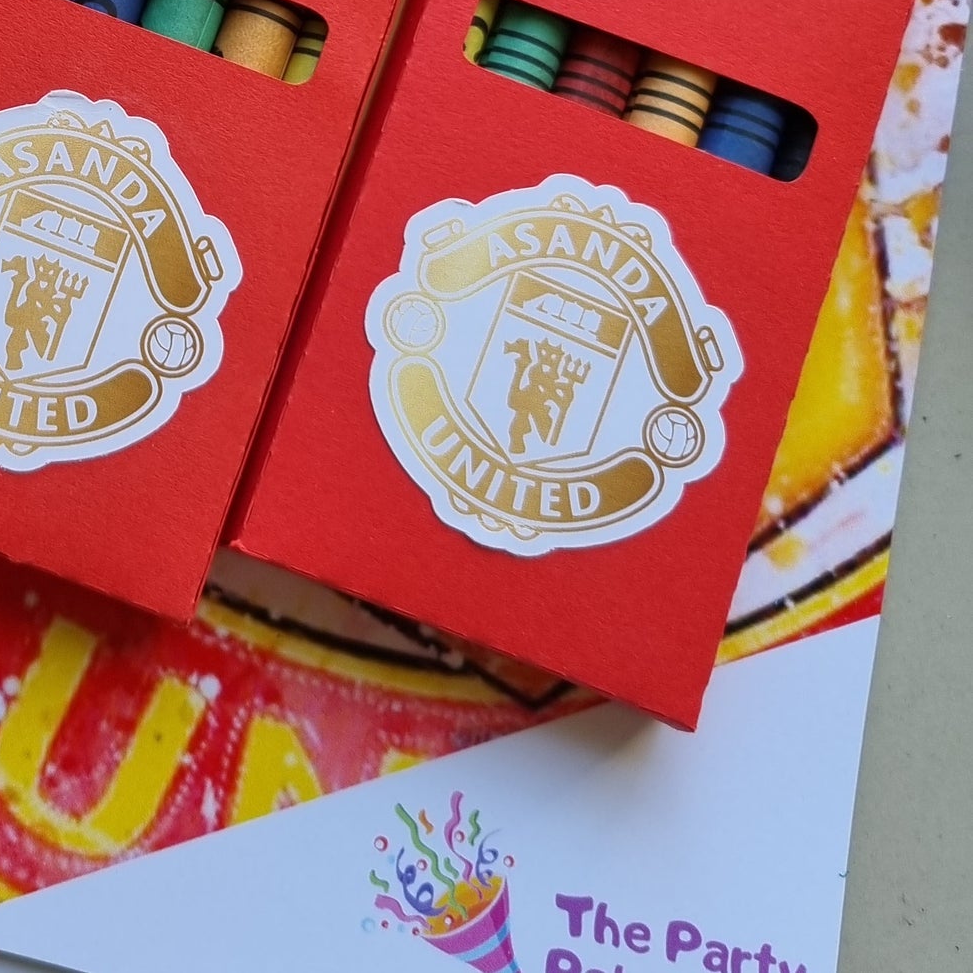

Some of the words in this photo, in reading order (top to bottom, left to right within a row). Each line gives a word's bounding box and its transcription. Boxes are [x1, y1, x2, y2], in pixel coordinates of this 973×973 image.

[487, 223, 668, 326] ASANDA
[421, 415, 602, 518] UNITED
[555, 893, 651, 954] The
